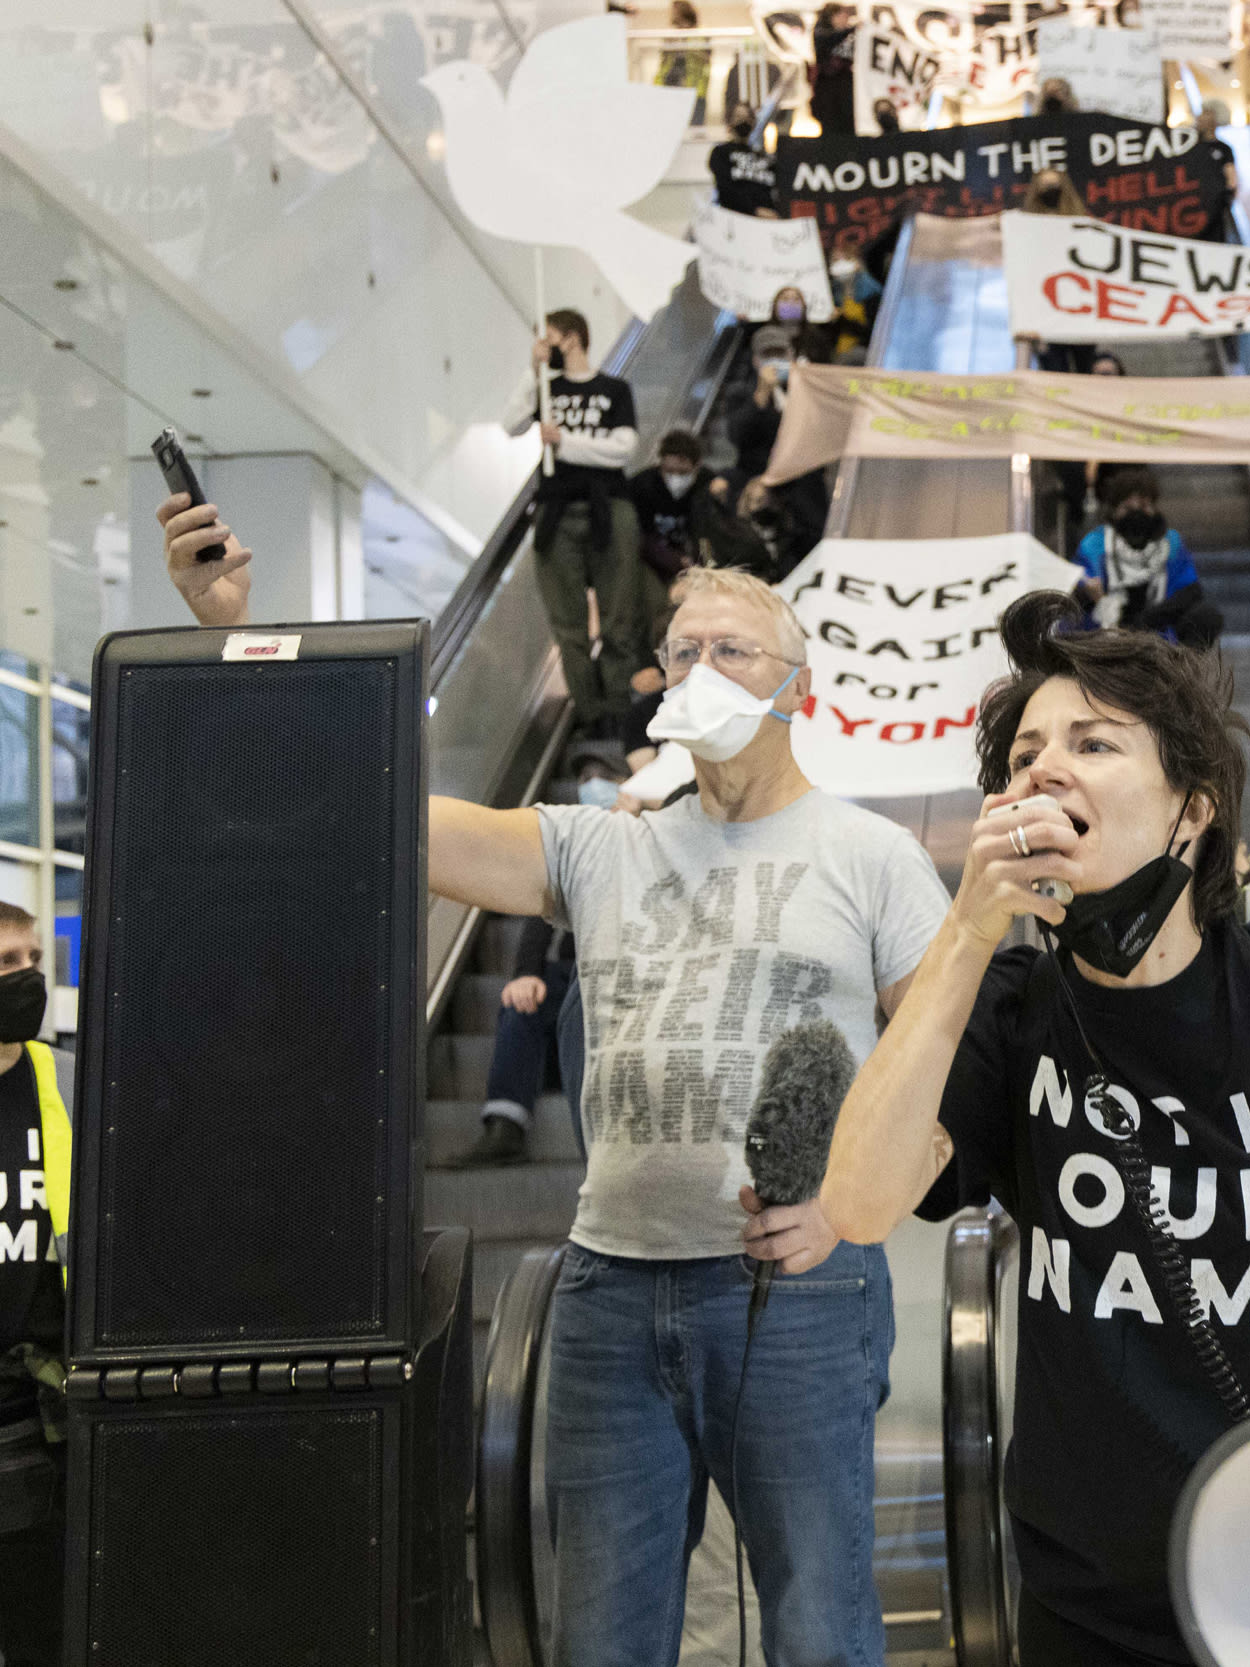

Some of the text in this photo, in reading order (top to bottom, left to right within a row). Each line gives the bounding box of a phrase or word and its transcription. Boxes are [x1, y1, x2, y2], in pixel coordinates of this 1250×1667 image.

[793, 149, 967, 193] MOURN
[977, 136, 1067, 180] THE
[1090, 127, 1200, 167] DEAD
[1087, 166, 1200, 204] HELL
[620, 862, 809, 956] SAY
